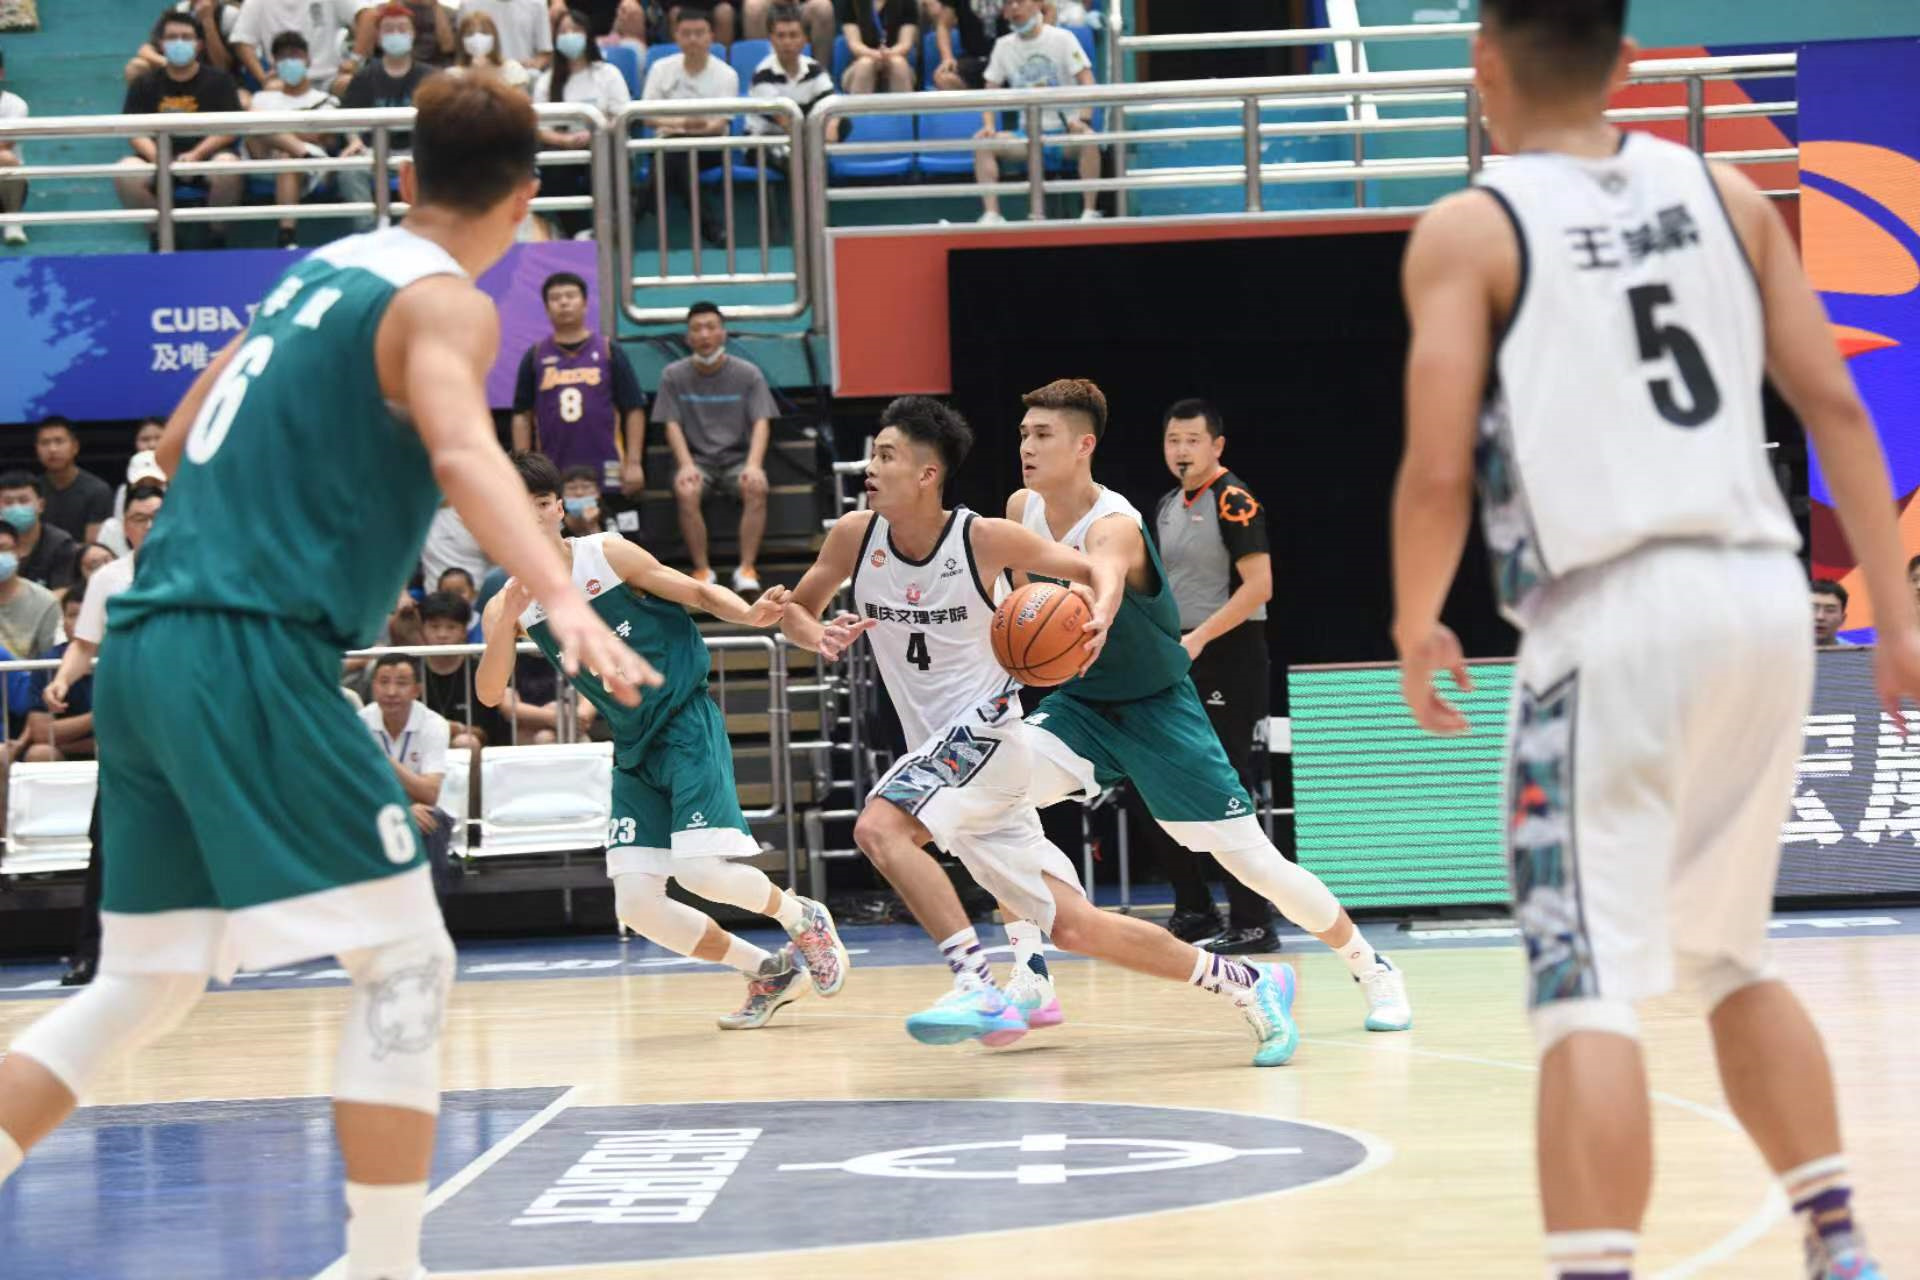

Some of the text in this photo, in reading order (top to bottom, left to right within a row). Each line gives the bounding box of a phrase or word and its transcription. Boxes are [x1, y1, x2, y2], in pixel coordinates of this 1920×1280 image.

[151, 306, 243, 332] CUBA
[1627, 283, 1721, 428] 5
[186, 334, 275, 465] 6
[559, 387, 583, 423] 8
[865, 602, 968, 625] 重庆文理学院
[906, 632, 932, 671] 4
[377, 804, 417, 865] 6
[608, 816, 637, 844] 23
[509, 1127, 764, 1227] RIGORER
